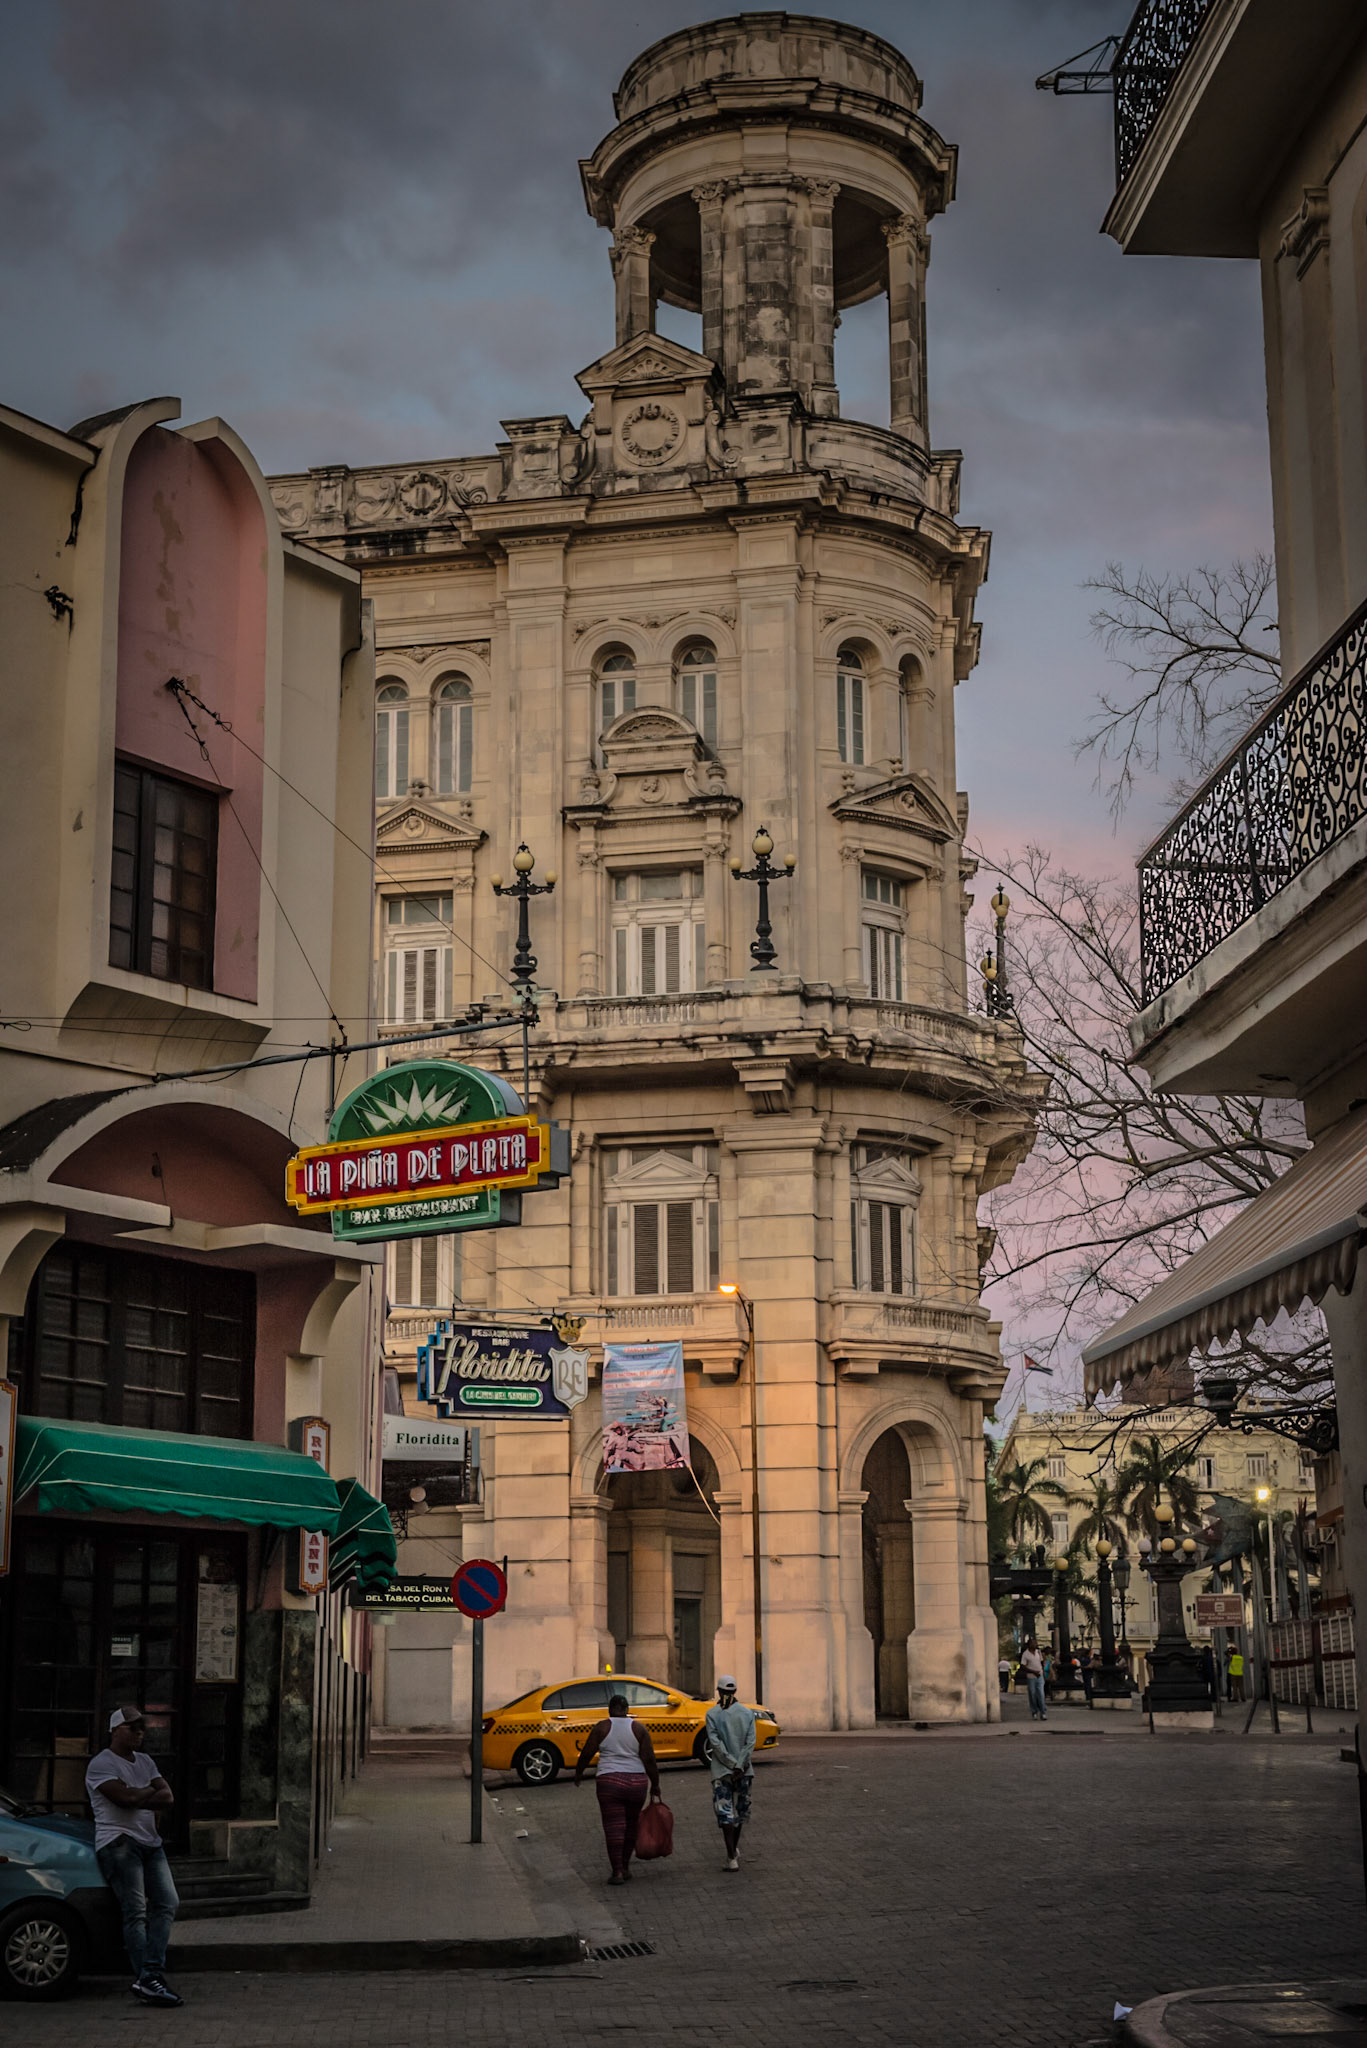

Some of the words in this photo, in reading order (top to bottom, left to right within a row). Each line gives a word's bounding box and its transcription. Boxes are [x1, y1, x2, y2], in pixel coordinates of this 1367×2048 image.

[304, 1161, 331, 1197] LA
[340, 1149, 398, 1192] PIÑA
[408, 1147, 442, 1183] DE
[451, 1134, 527, 1177] PLATA
[350, 1208, 381, 1224] BAR
[396, 1432, 459, 1445] Floridita
[385, 1594, 420, 1602] TABACO
[422, 1595, 454, 1603] CUBAN
